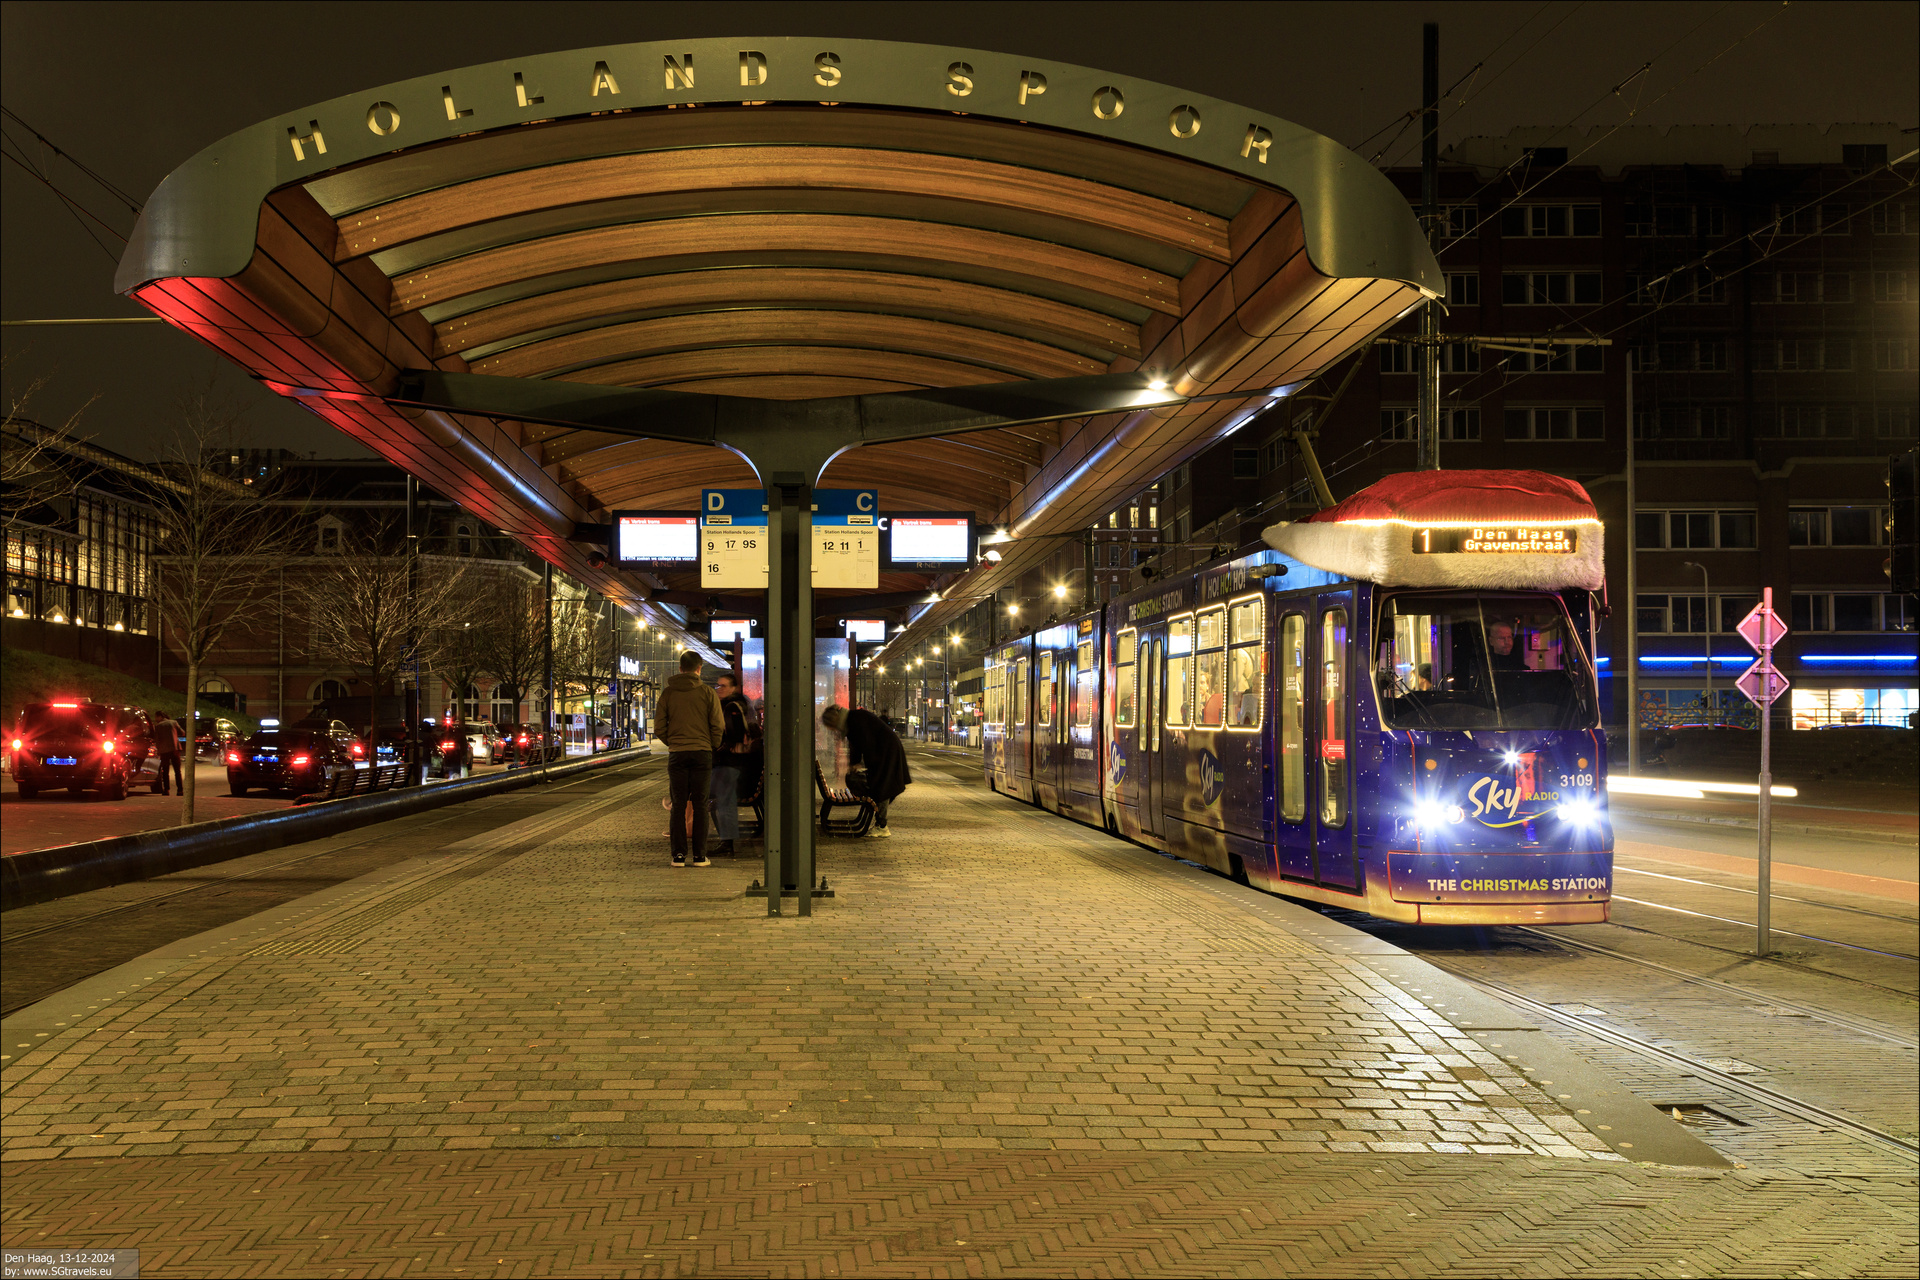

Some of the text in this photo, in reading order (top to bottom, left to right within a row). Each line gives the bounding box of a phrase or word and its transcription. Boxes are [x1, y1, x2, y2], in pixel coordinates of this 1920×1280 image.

[287, 49, 1273, 164] HOLLANDS SPOOR
[708, 493, 724, 511] D
[856, 492, 872, 511] C
[878, 518, 888, 530] C
[1420, 528, 1430, 552] 1
[1473, 528, 1564, 541] Den Haag
[707, 542, 714, 550] 9
[725, 540, 736, 548] 17
[742, 540, 756, 549] 9S
[822, 542, 834, 550] 12
[840, 542, 849, 550] 11
[1464, 539, 1570, 551] Gravenstraat
[707, 564, 719, 572] 16
[1208, 568, 1246, 599] HO! HO! HO!
[1136, 596, 1162, 619] CHRISTMAS
[1162, 589, 1183, 612] STATION
[1201, 753, 1223, 800] Sky RADIO
[1560, 774, 1592, 787] 3109
[1468, 776, 1559, 819] Sky RADIO
[1428, 877, 1606, 891] THE CHRISTMAS STATION
